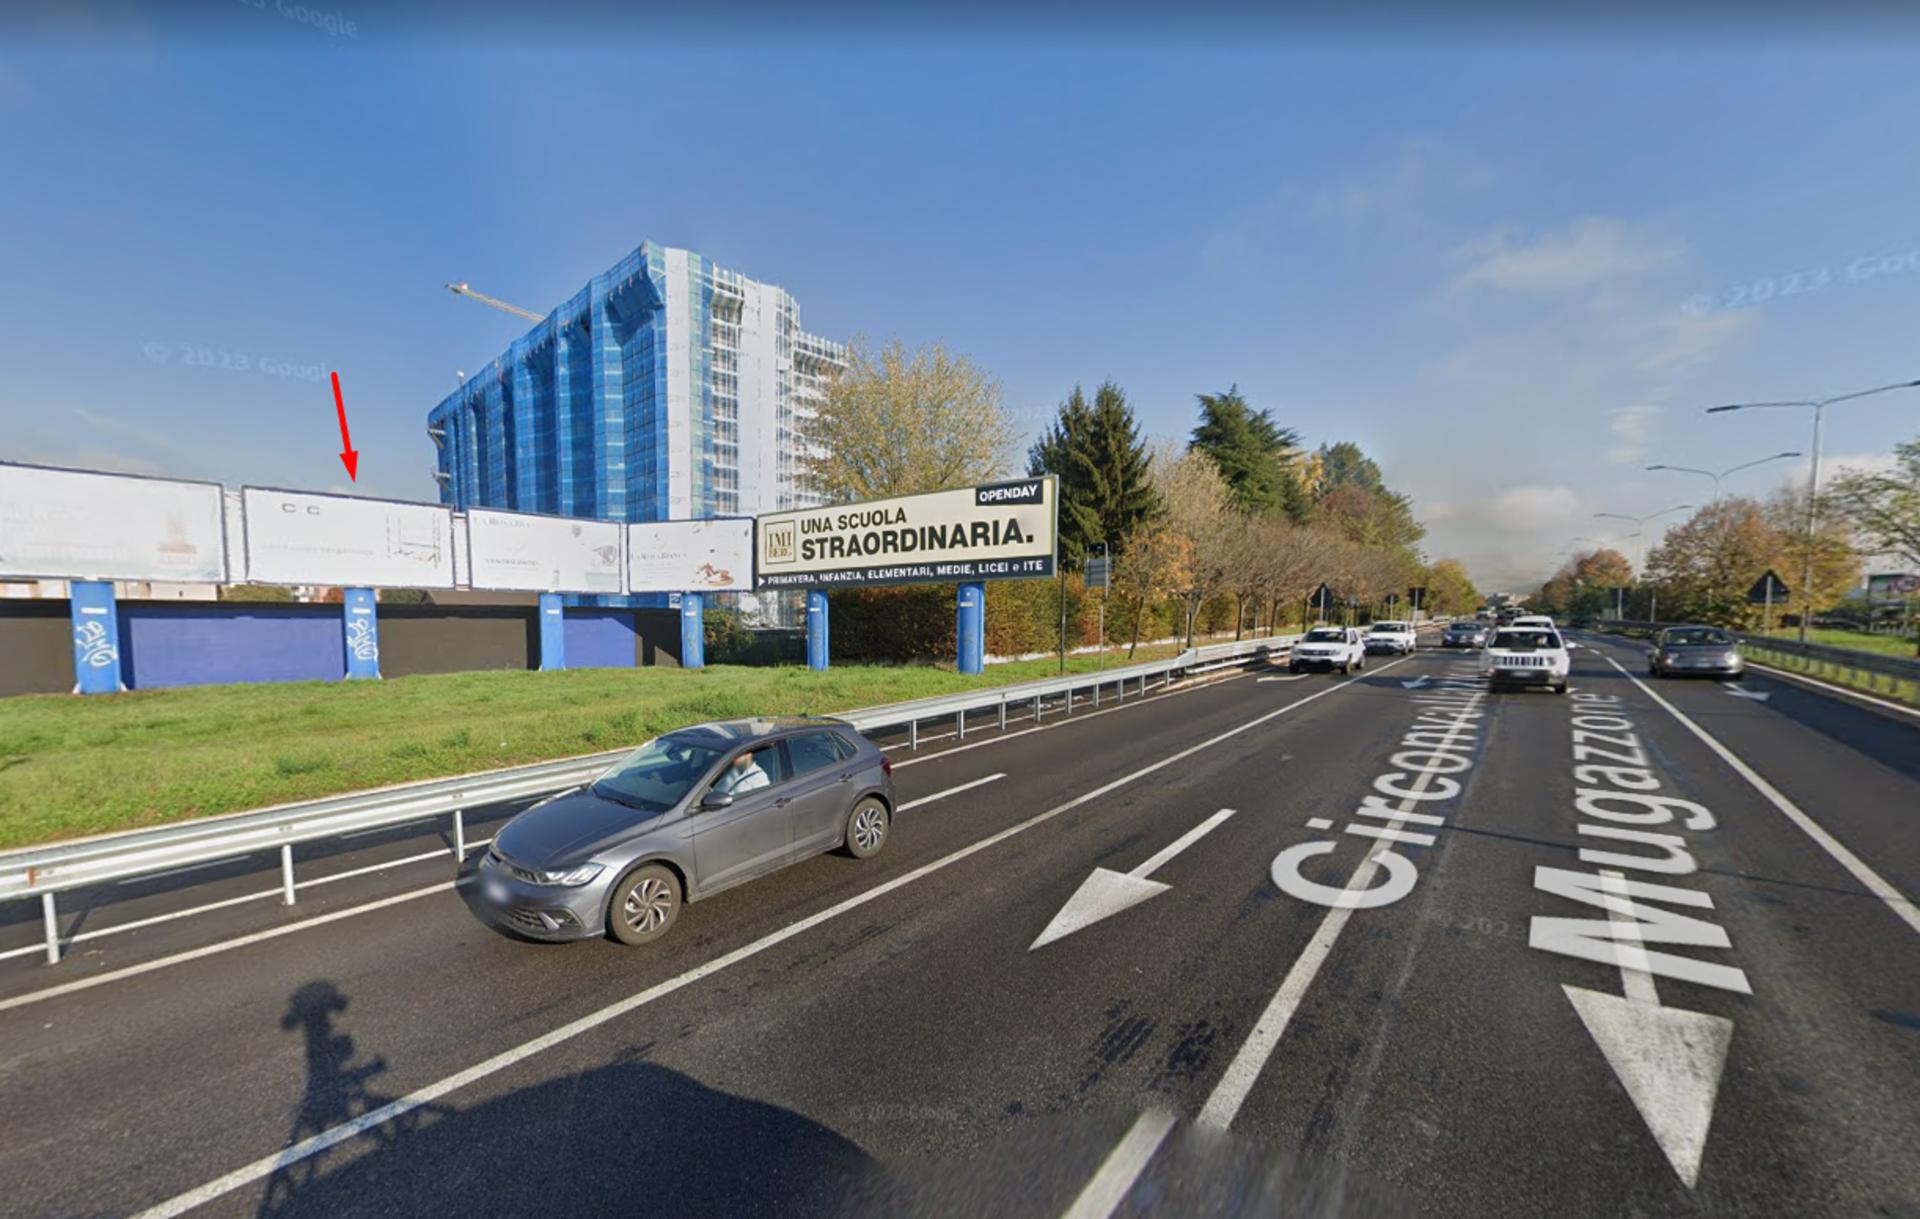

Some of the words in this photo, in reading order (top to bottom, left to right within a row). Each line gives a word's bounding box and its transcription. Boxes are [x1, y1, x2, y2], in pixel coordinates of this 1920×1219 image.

[979, 484, 1038, 502] OPENDAY
[801, 518, 833, 535] UNA
[838, 507, 907, 528] SCUOLA
[801, 518, 1035, 561] STRAORDINARIA.
[768, 574, 818, 585] PRIMAVERA,
[820, 571, 865, 582] INFANZIA,
[868, 568, 934, 579] ELEMENTARI,
[936, 564, 975, 576] MEDIE,
[978, 562, 1009, 573] LICEI
[1024, 560, 1043, 571] ITE
